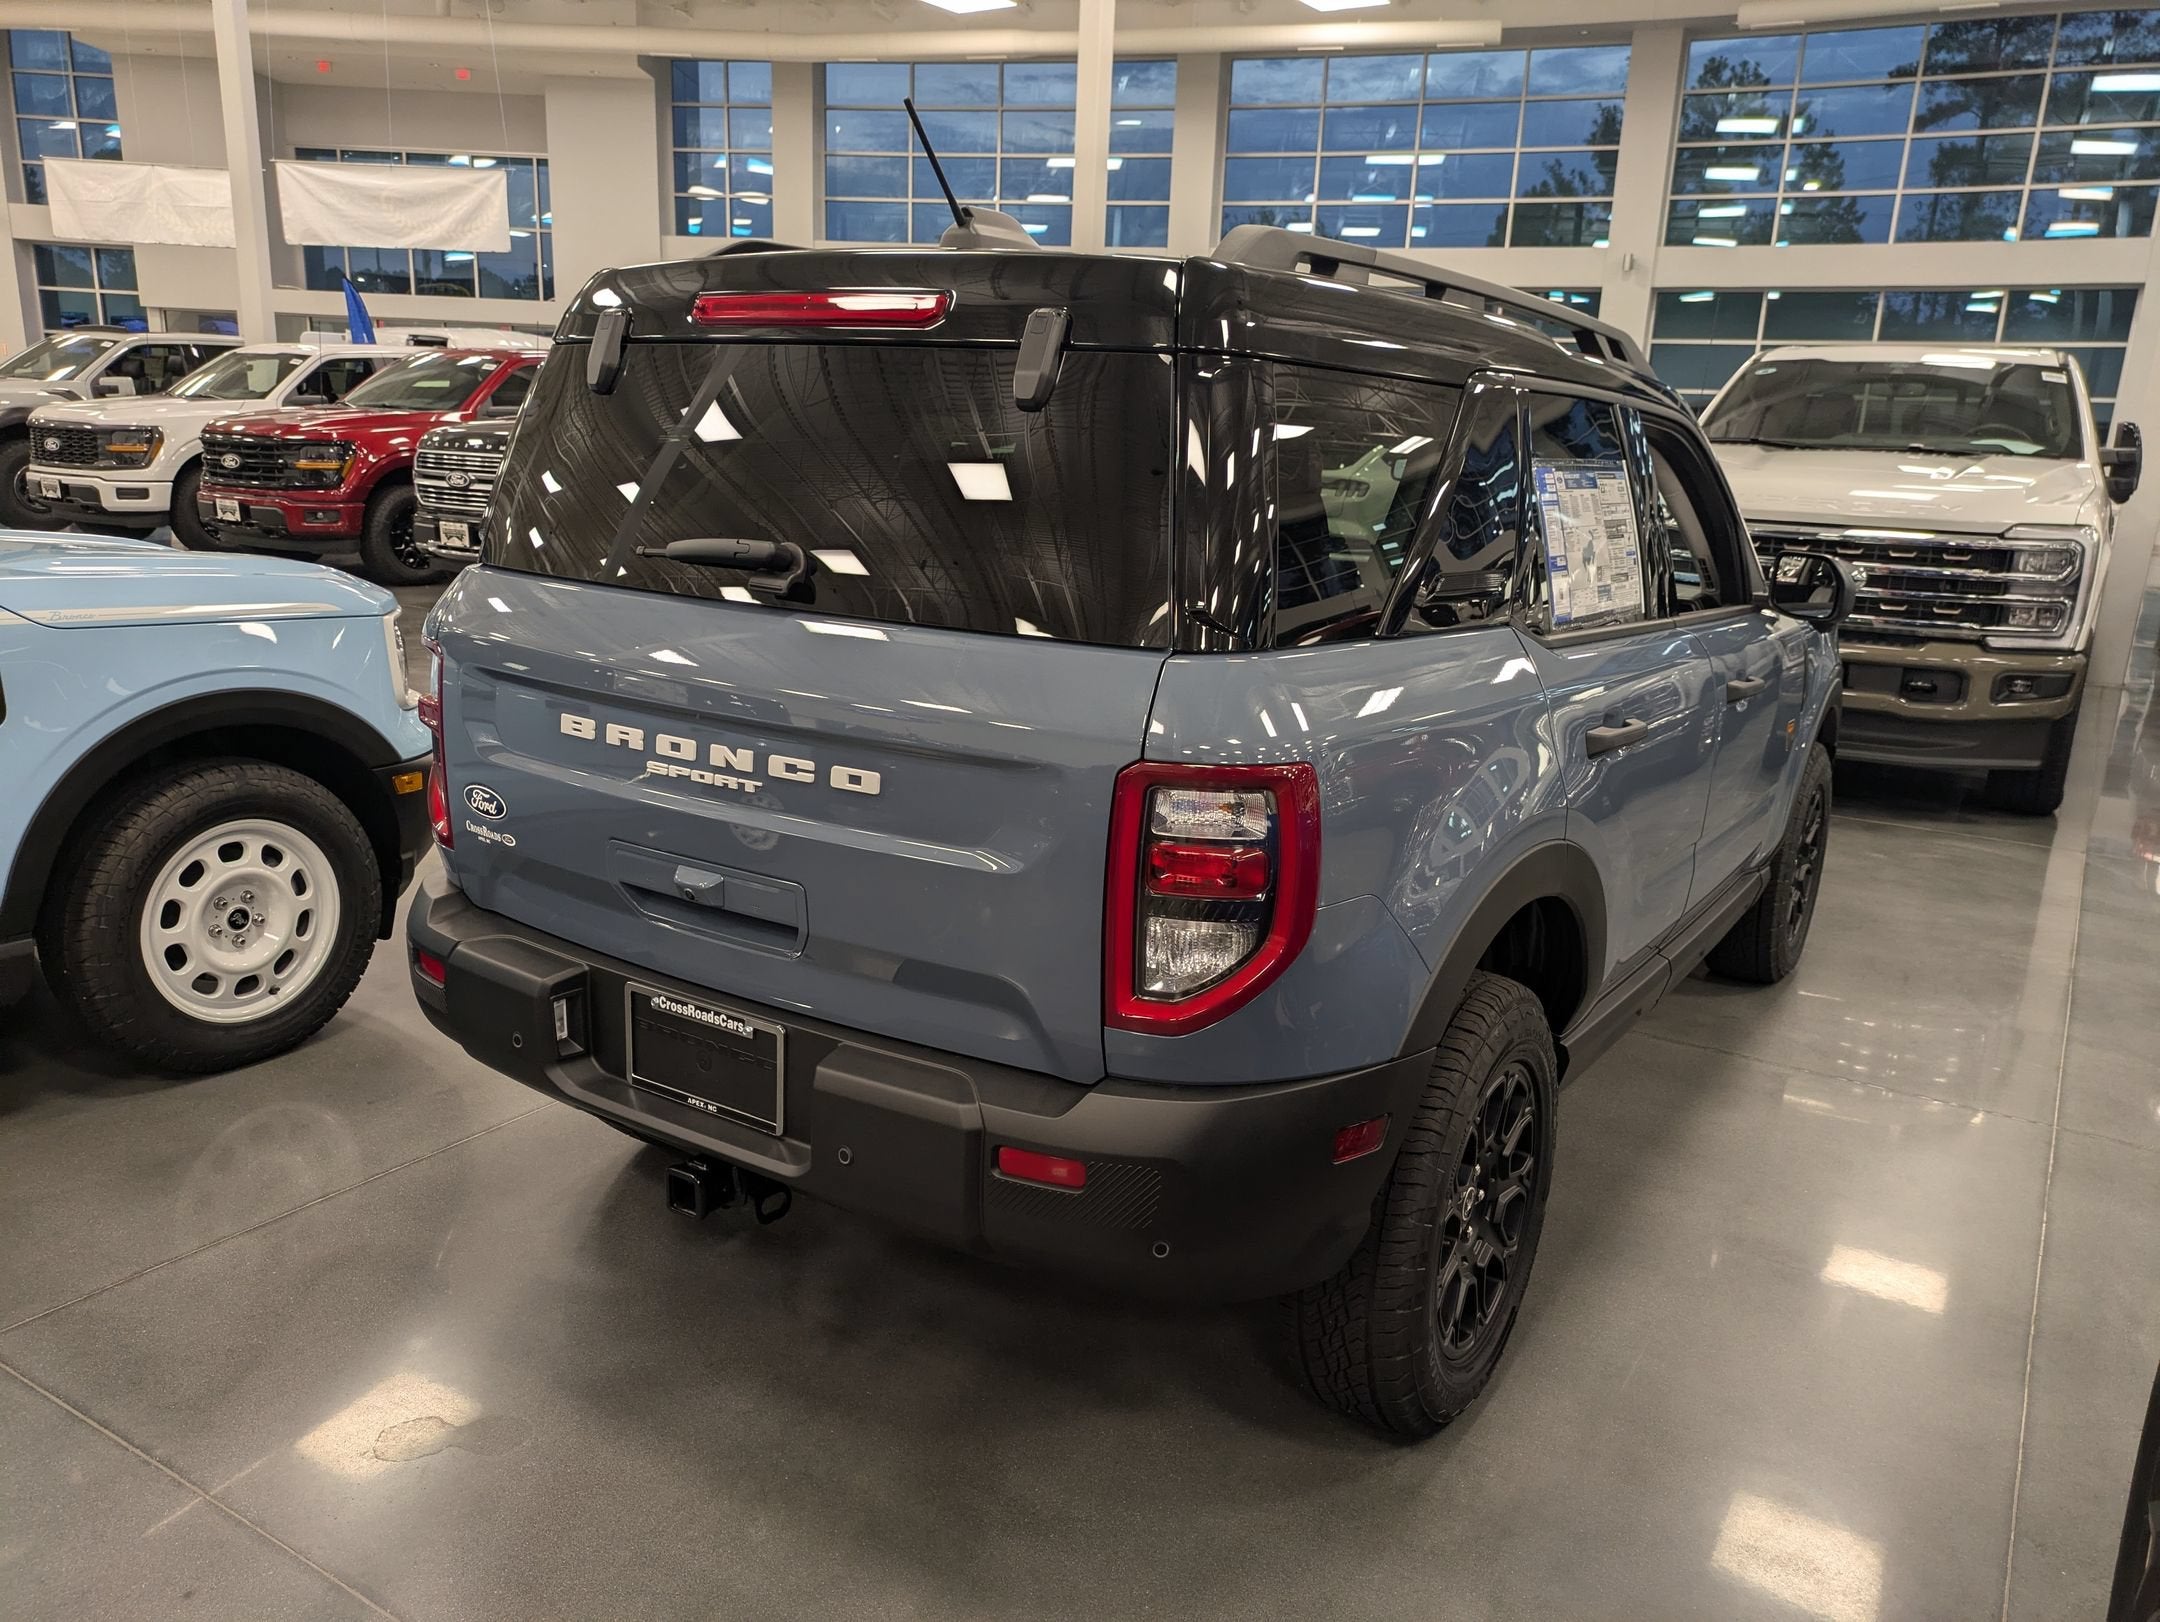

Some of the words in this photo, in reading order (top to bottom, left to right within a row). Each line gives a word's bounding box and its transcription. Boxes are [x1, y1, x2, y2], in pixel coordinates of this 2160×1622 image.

[560, 712, 881, 796] BRONCO
[646, 760, 763, 793] SPORT
[470, 788, 499, 816] Ford
[659, 996, 744, 1033] CrossRoadsCars
